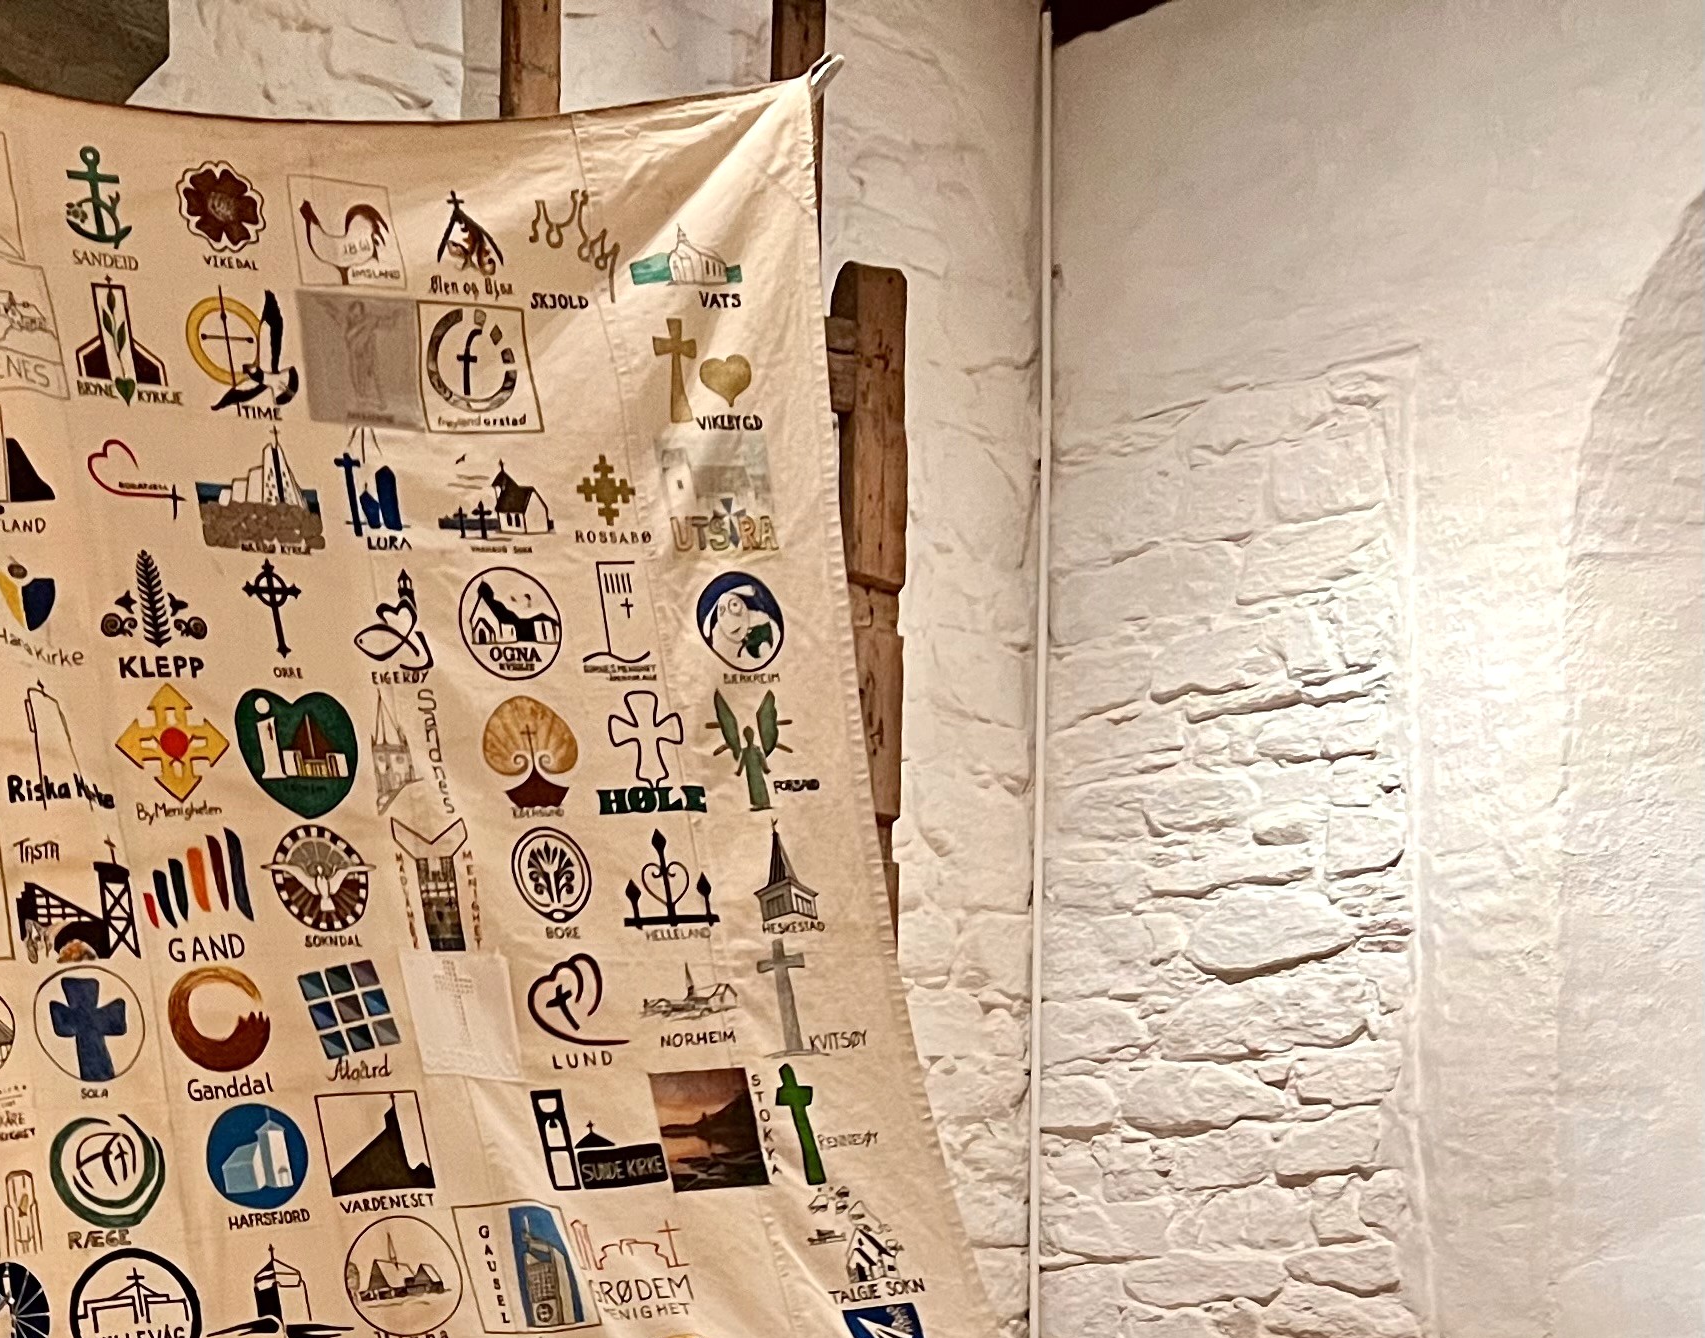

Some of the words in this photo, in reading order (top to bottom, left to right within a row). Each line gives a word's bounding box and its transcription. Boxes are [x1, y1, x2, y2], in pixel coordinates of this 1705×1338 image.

[73, 249, 138, 271] SANDEID
[203, 255, 259, 270] VIKEDAL
[352, 268, 400, 279] IMSLAND
[464, 282, 478, 300] og
[698, 290, 742, 308] VATS
[530, 292, 588, 310] SKJOLD
[77, 380, 119, 400] BRYNE
[138, 390, 184, 406] KYRKJE
[242, 404, 282, 421] TIME
[366, 536, 412, 550] LURA
[576, 530, 652, 544] ROSSABØ
[490, 646, 542, 662] OGNA
[118, 656, 204, 678] KLEPP
[274, 666, 304, 679] ORRE
[372, 670, 429, 685] EIGERØY
[418, 688, 455, 814] Sandnes
[8, 774, 72, 804] Riska
[596, 786, 708, 814] HØLE
[13, 837, 60, 865] TASTA
[546, 926, 581, 940] BORE
[646, 926, 711, 941] HELLELAND
[762, 920, 825, 934] HESKESTAD
[168, 933, 245, 962] GAND
[304, 934, 362, 948] SOKNDAL
[660, 1029, 736, 1048] NORHEIM
[808, 1030, 867, 1051] KVITSØY
[552, 1050, 612, 1070] LUND
[80, 1088, 108, 1099] SOLA
[188, 1072, 274, 1102] Ganddal
[340, 1193, 434, 1214] VARDENESET
[228, 1208, 310, 1230] HAFRSFJORD
[68, 1230, 132, 1250] RÆGE
[478, 1225, 510, 1324] GAUSEL
[886, 1278, 926, 1296] SOKN
